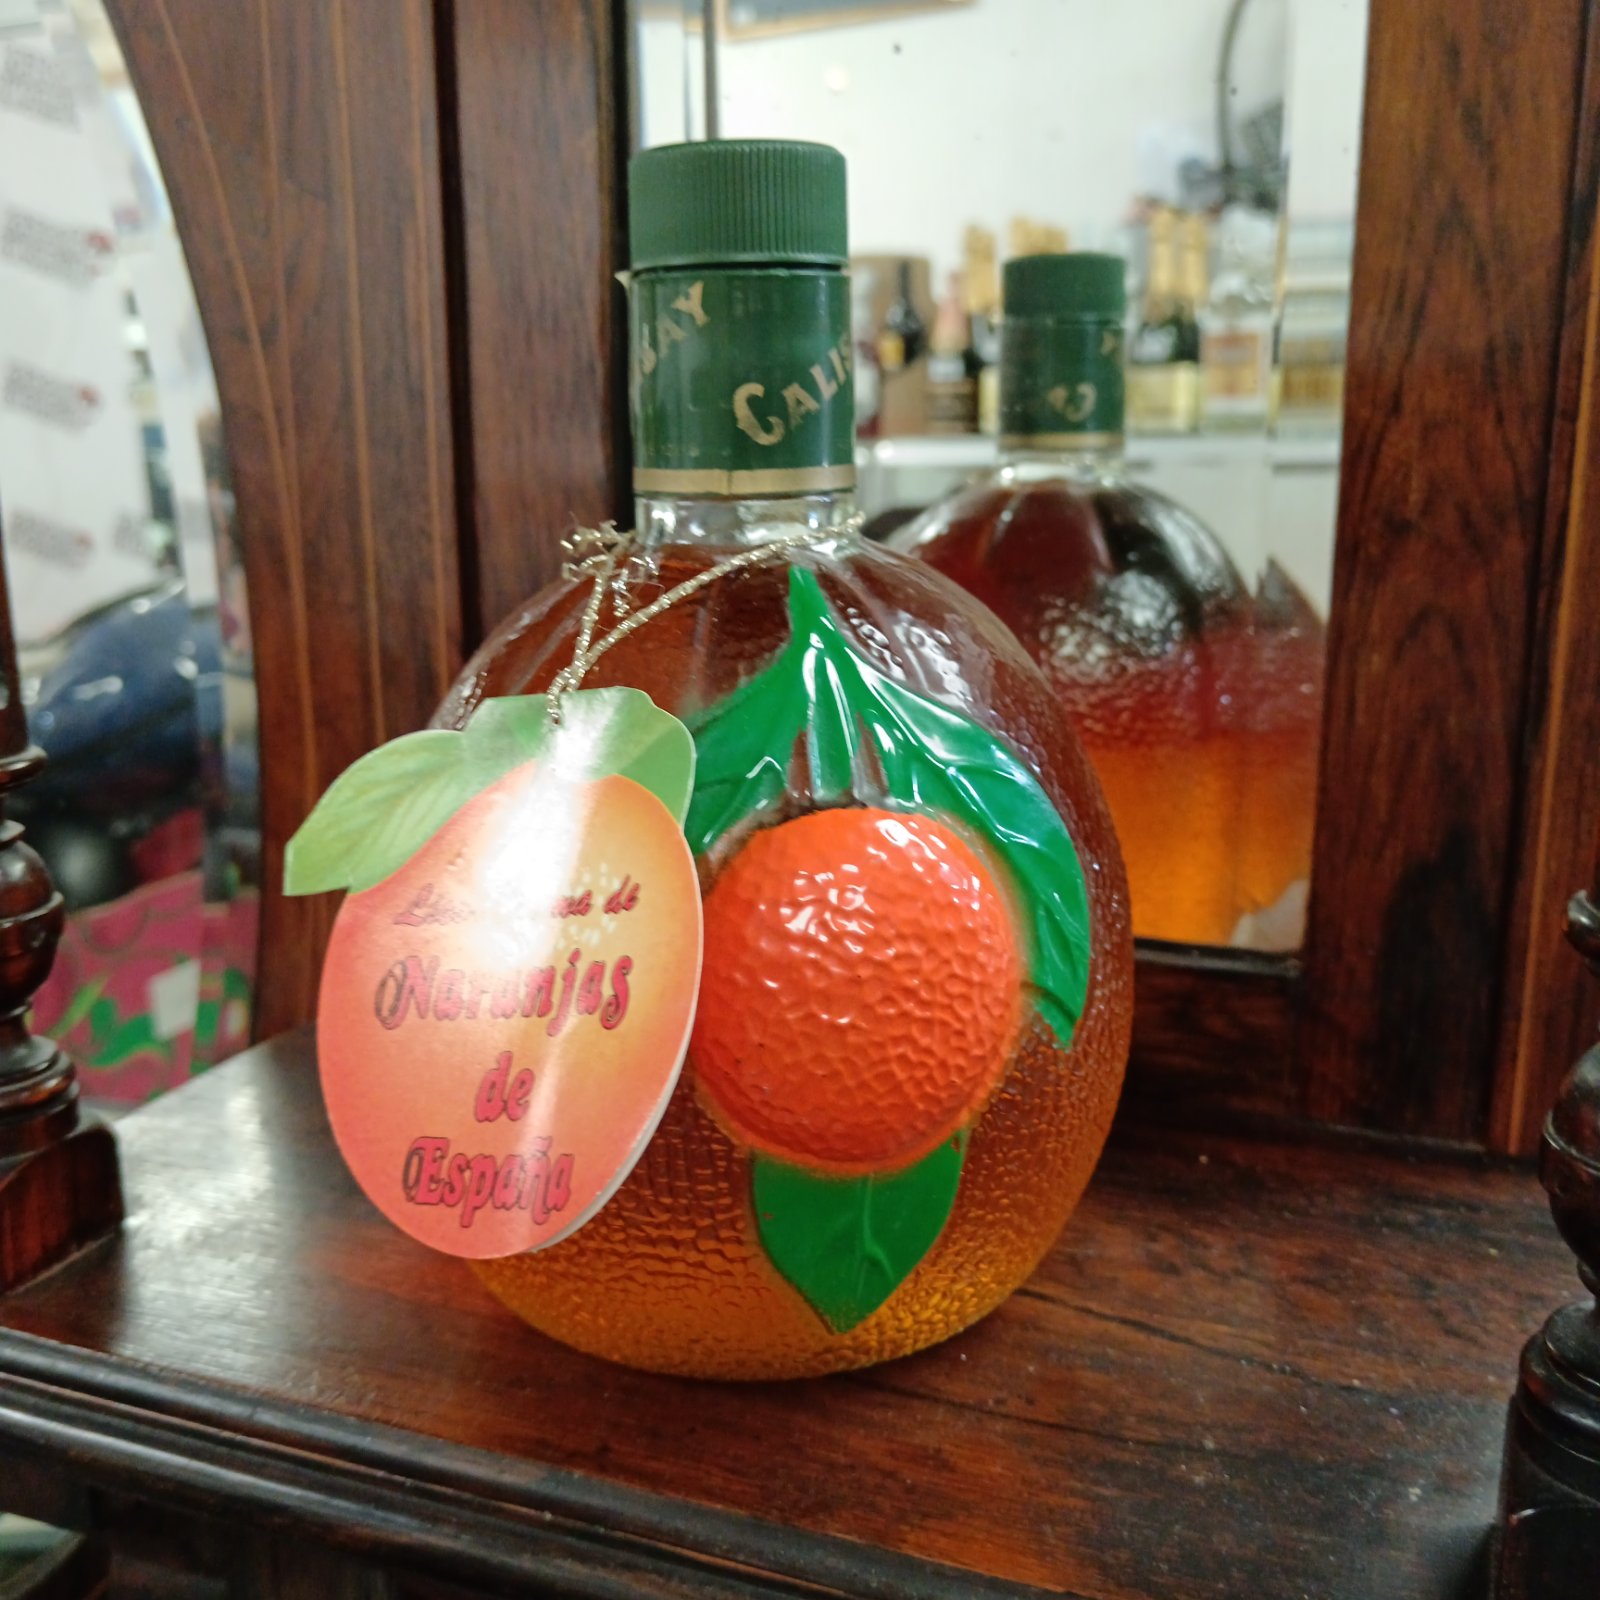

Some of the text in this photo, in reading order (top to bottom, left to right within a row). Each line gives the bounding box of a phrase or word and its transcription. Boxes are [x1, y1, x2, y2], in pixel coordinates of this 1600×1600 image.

[604, 875, 641, 914] de
[374, 948, 633, 1037] Naranjas
[474, 1050, 535, 1123] de
[403, 1136, 574, 1228] España
